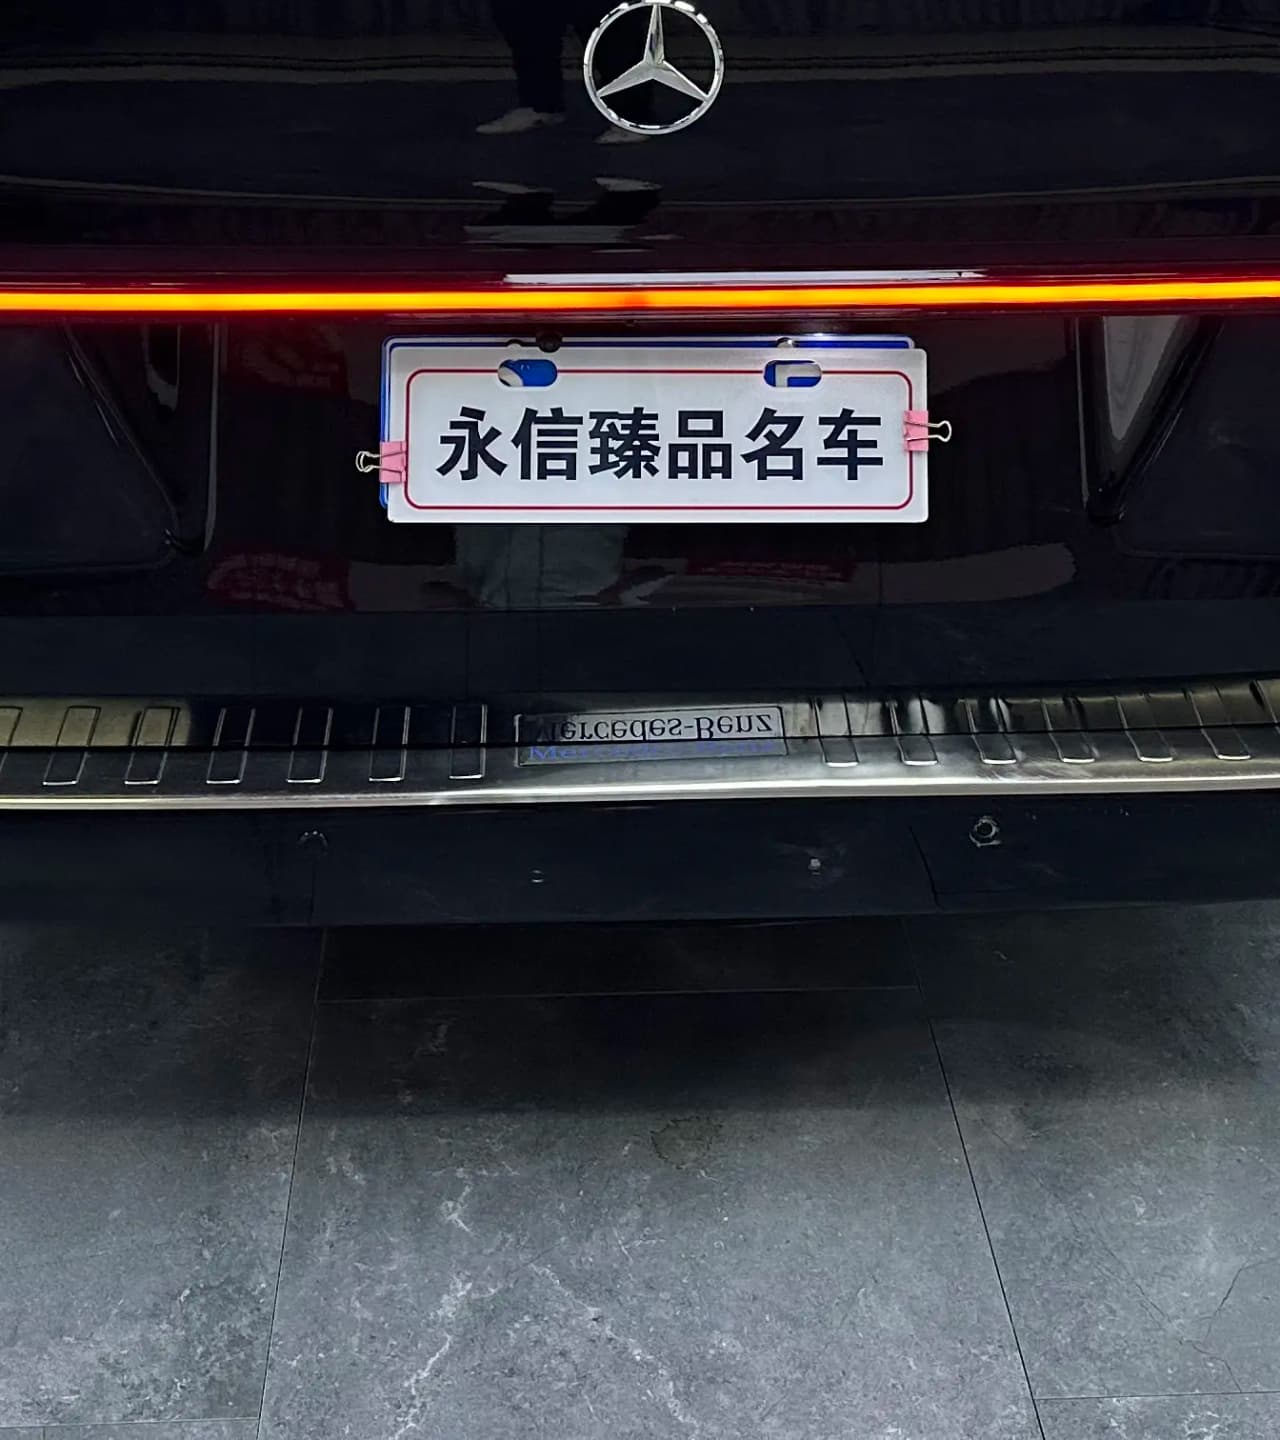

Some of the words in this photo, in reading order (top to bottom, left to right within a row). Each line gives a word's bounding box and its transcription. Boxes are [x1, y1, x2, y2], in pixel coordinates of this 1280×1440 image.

[435, 406, 885, 481] 永信臻品名车
